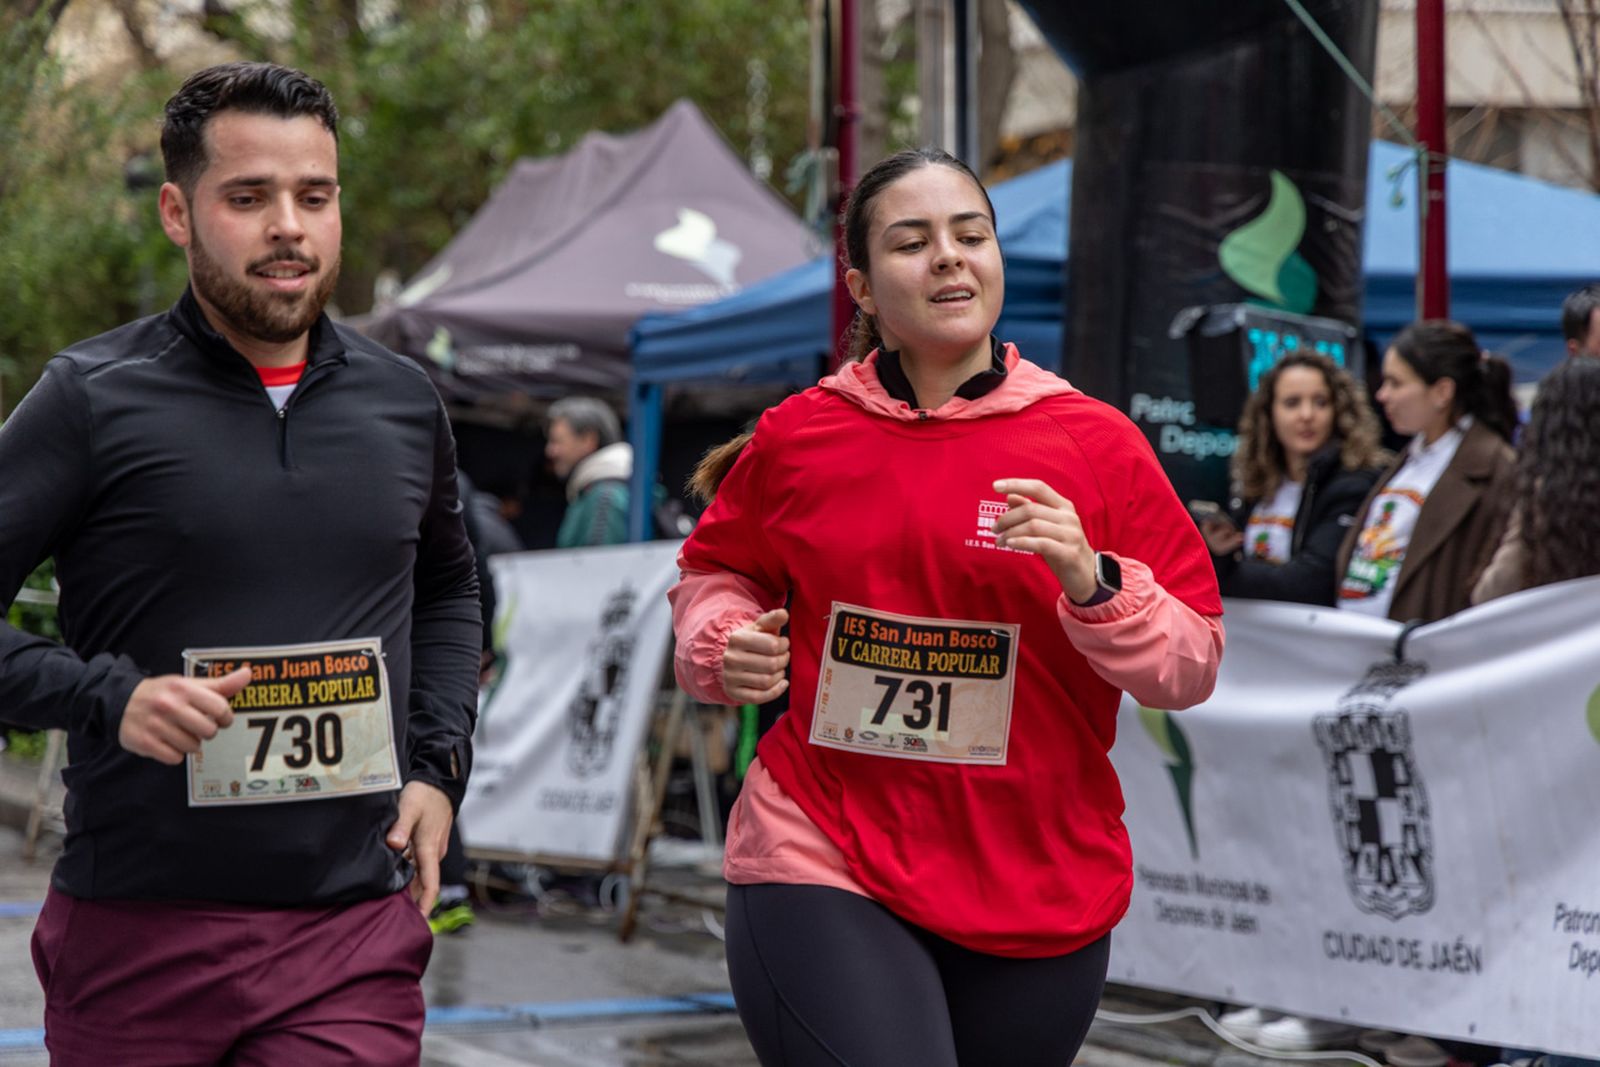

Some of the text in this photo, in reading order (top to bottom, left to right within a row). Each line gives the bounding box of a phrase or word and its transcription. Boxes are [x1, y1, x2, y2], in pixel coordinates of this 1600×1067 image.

[844, 616, 997, 649] IES San Juan Bosco
[241, 661, 276, 680] an
[281, 658, 321, 679] Juan
[324, 655, 369, 675] Bosco
[837, 637, 1001, 675] V CARRERA POPULAR
[229, 676, 376, 707] ARRERA POPULAR
[870, 675, 952, 732] 731
[247, 712, 343, 772] 730
[1323, 930, 1483, 976] CIUDAD DE JAÉN
